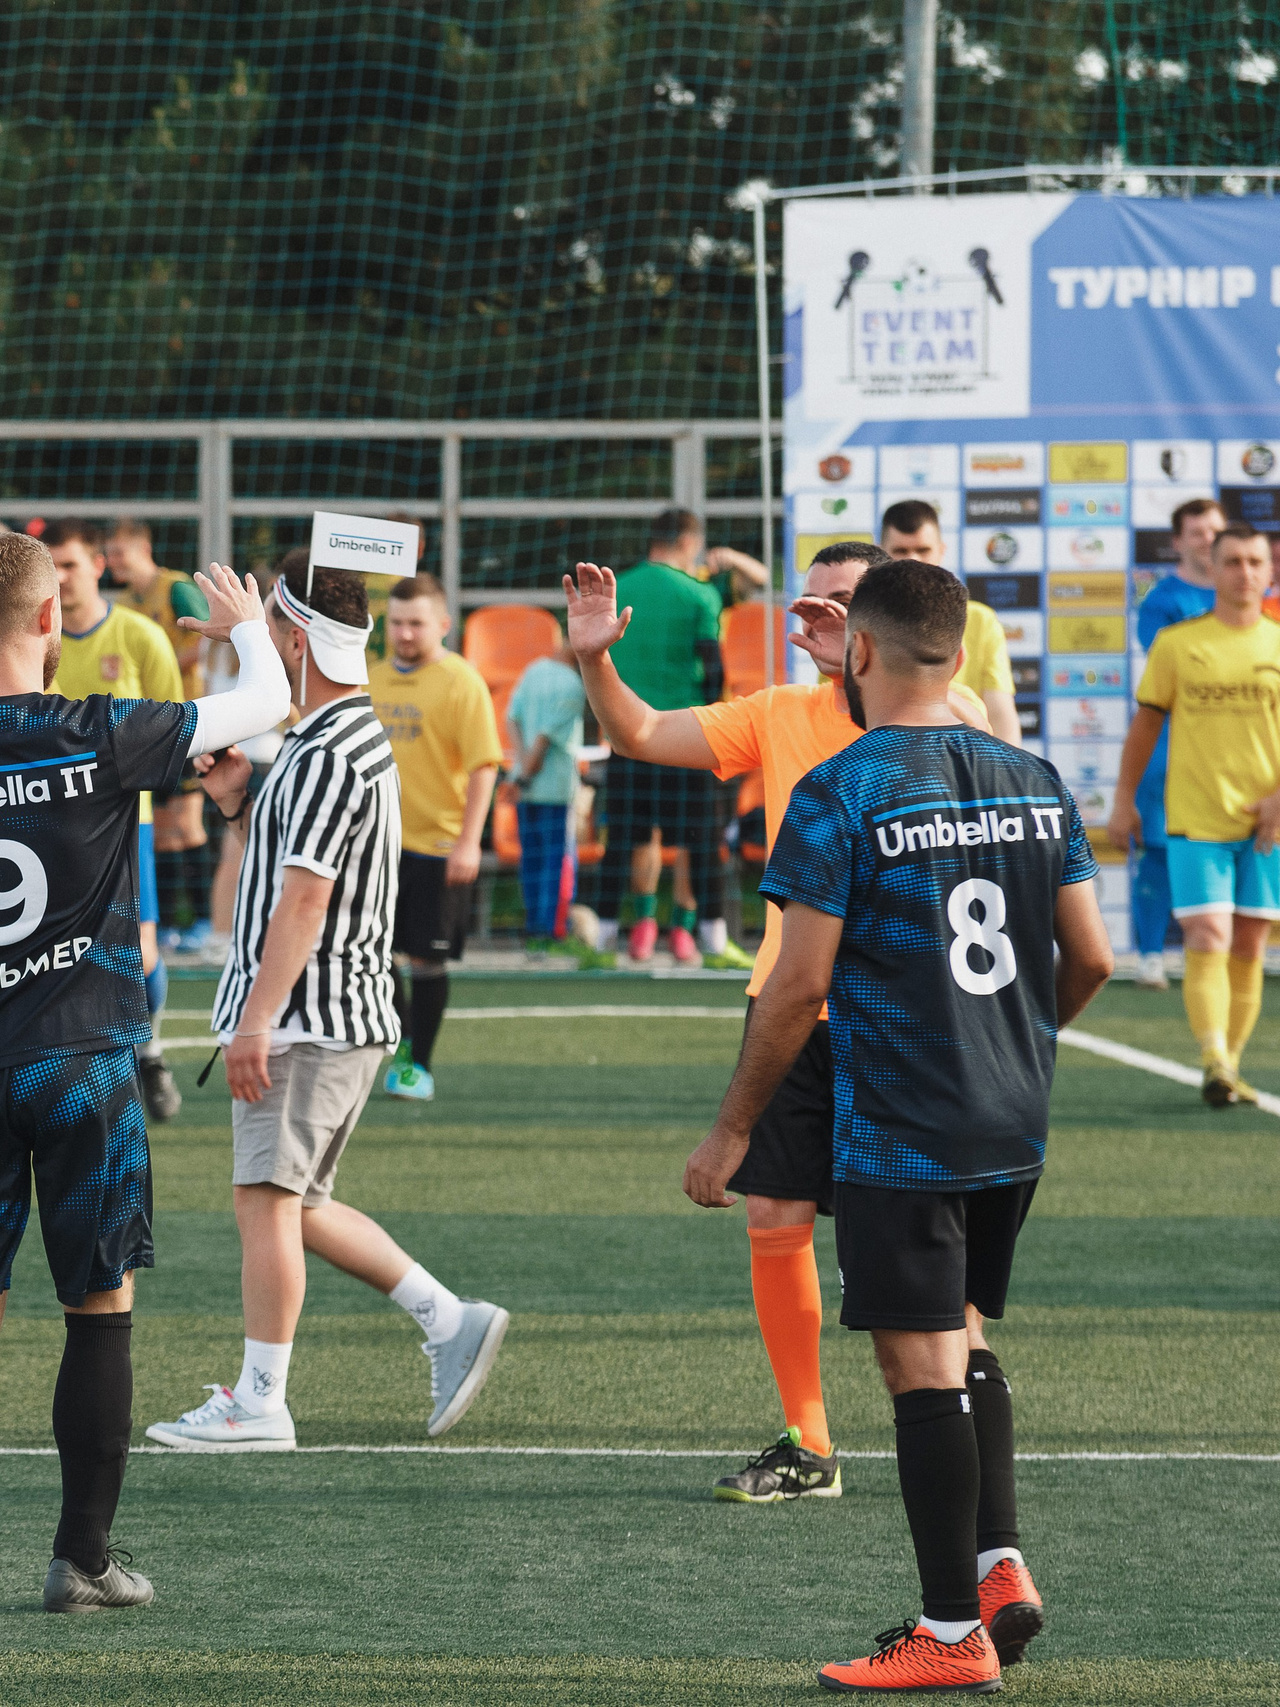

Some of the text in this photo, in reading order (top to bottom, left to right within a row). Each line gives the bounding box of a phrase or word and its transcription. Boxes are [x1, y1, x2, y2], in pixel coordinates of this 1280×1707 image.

[1051, 266, 1257, 308] ТУРНИР
[861, 308, 975, 335] EVENT
[862, 339, 977, 364] TEAM
[329, 537, 404, 556] Umbrella IT
[60, 762, 98, 799] IT
[876, 807, 1063, 857] Umbrella IT
[947, 878, 1017, 995] 8
